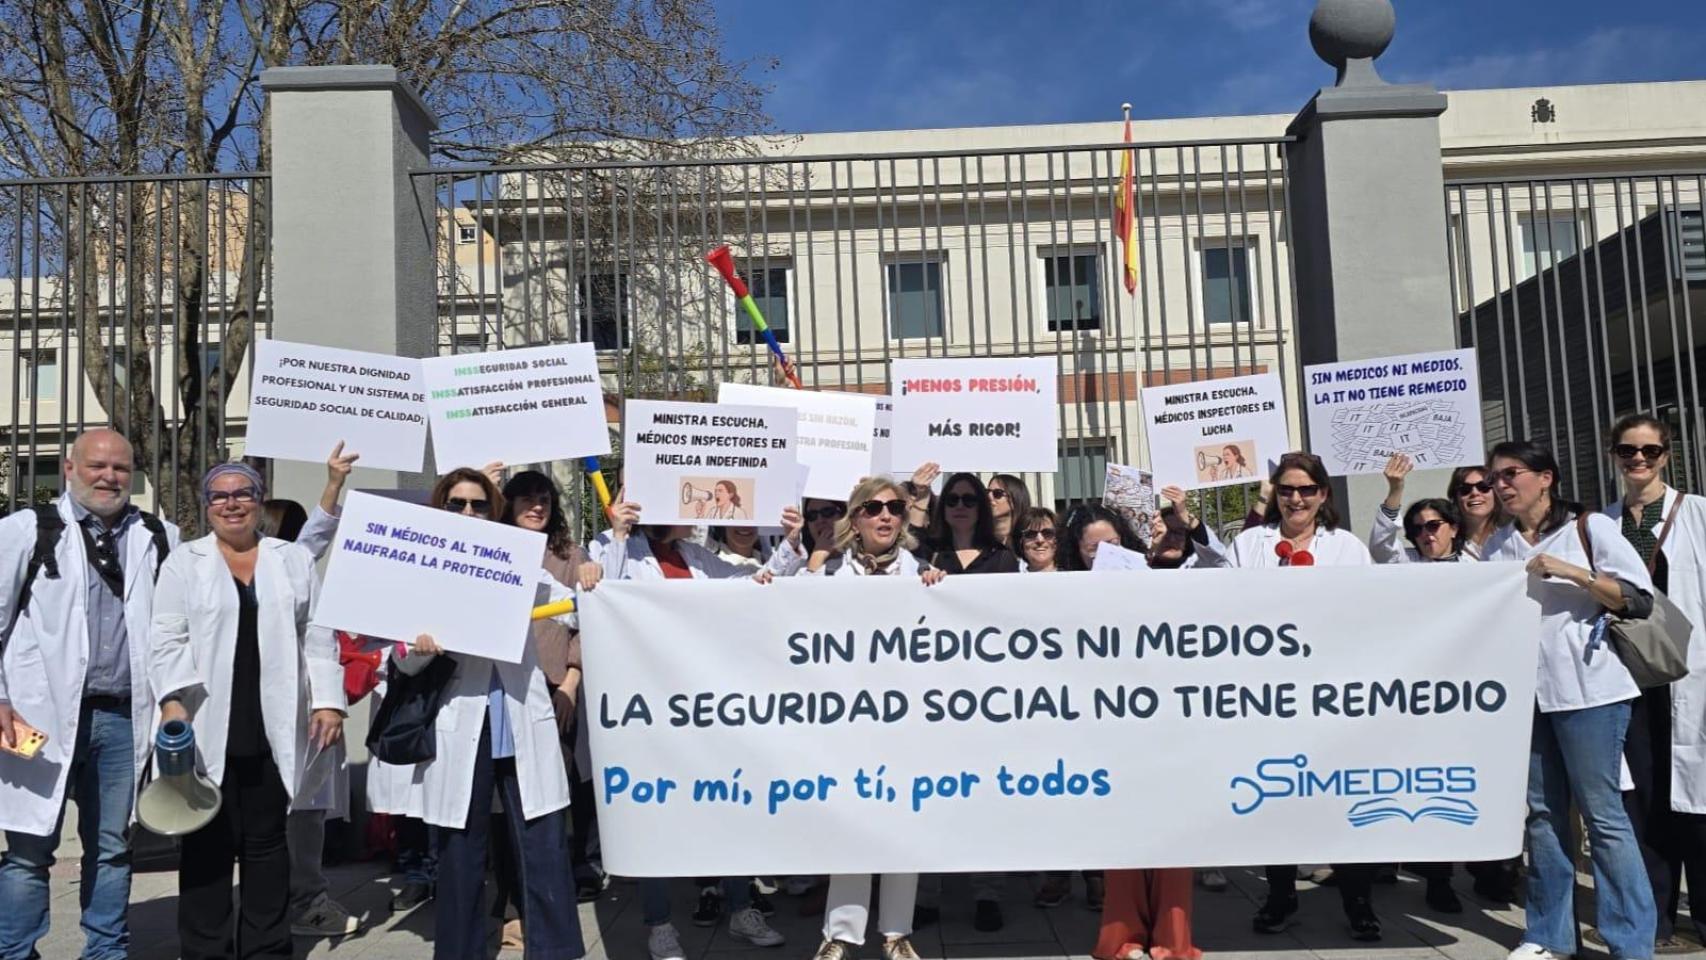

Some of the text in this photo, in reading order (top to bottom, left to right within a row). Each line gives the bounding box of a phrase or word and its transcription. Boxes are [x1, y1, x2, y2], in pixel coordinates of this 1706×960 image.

[279, 357, 410, 381] ¡POR NUESTRA DIGNIDAD
[532, 358, 568, 369] SOCIAL
[527, 374, 595, 389] PROFESIONAL
[1312, 372, 1332, 385] SIN
[1336, 365, 1388, 382] MEDICOS
[1392, 364, 1408, 376] NI
[262, 374, 425, 402] PROFESIONAL Y UN SISTEMA DE
[902, 374, 1040, 396] ¡MENOS PRESIÓN,
[1314, 379, 1467, 404] LA IT NO TIENE REMEDIO
[255, 396, 317, 411] SEGURIDAD
[319, 404, 358, 416] SOCIAL
[361, 408, 374, 418] DE
[542, 396, 588, 409] GENERAL
[1164, 392, 1209, 406] MINISTRA
[653, 413, 708, 426] MINISTRA
[1154, 402, 1275, 425] MÉDICOS INSPECTORES EN
[1350, 414, 1361, 422] IT
[928, 418, 1021, 438] MÁS RIGOR!
[1202, 424, 1234, 436] LUCHA
[1364, 425, 1374, 433] IT
[636, 430, 786, 449] MÉDICOS INSPECTORES EN
[1400, 434, 1410, 442] IT
[656, 454, 768, 468] HUELGA INDEFINIDA
[1353, 462, 1366, 471] IT
[1415, 452, 1428, 464] IT
[366, 522, 387, 537] SIN
[391, 526, 447, 549] MÉDICOS
[450, 541, 467, 554] AL
[344, 539, 524, 587] NAUFRAGA LA PROTECCIÓN.
[788, 615, 1312, 665] SIN MÉDICOS NI MEDIOS,
[600, 678, 1507, 729] LA SEGURIDAD SOCIAL NO TIENE REMEDIO
[604, 758, 1111, 815] Por mí, por tí, por todos
